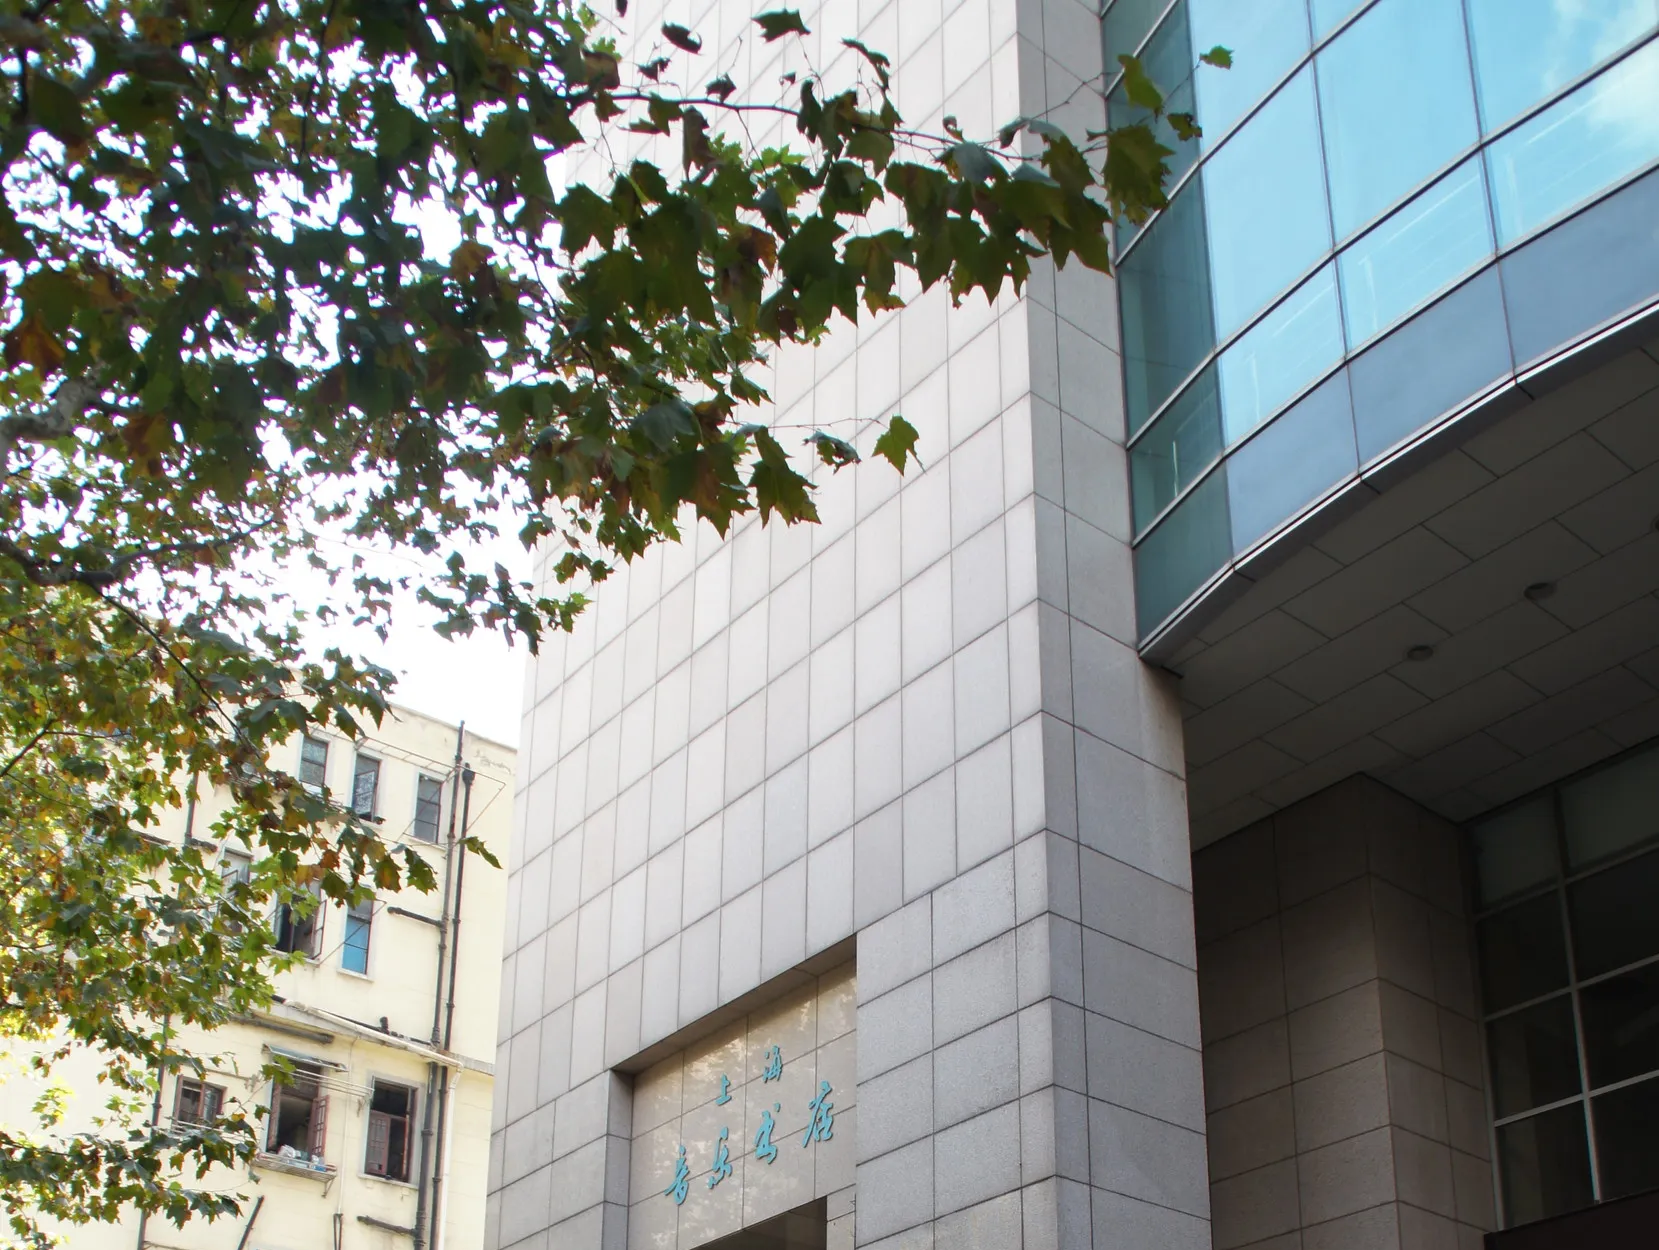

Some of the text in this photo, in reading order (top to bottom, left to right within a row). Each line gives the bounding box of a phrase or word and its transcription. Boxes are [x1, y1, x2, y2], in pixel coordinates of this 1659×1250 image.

[714, 1044, 783, 1106] 上海
[664, 1079, 834, 1206] 音乐书店
